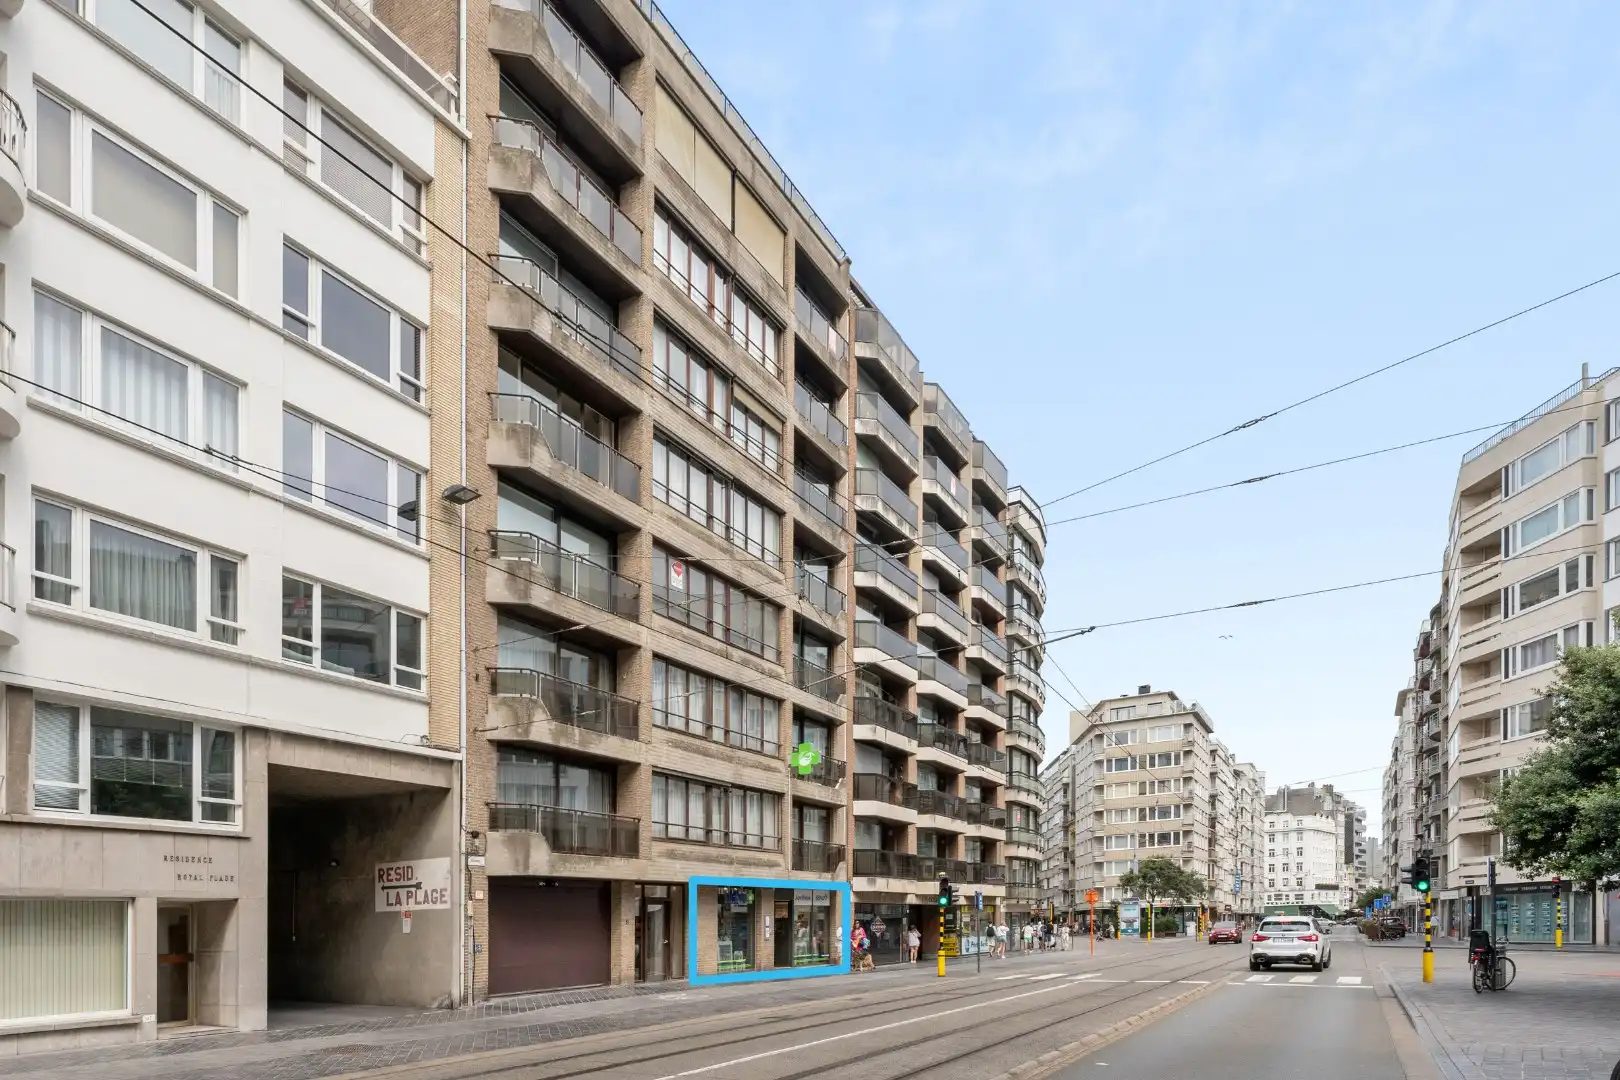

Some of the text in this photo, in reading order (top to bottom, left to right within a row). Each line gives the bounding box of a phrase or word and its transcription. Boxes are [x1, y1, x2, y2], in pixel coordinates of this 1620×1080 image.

[163, 855, 213, 864] RESIDENCE
[177, 873, 203, 881] ROYAL
[377, 865, 418, 883] RESID.
[386, 888, 448, 907] LA PLAGE
